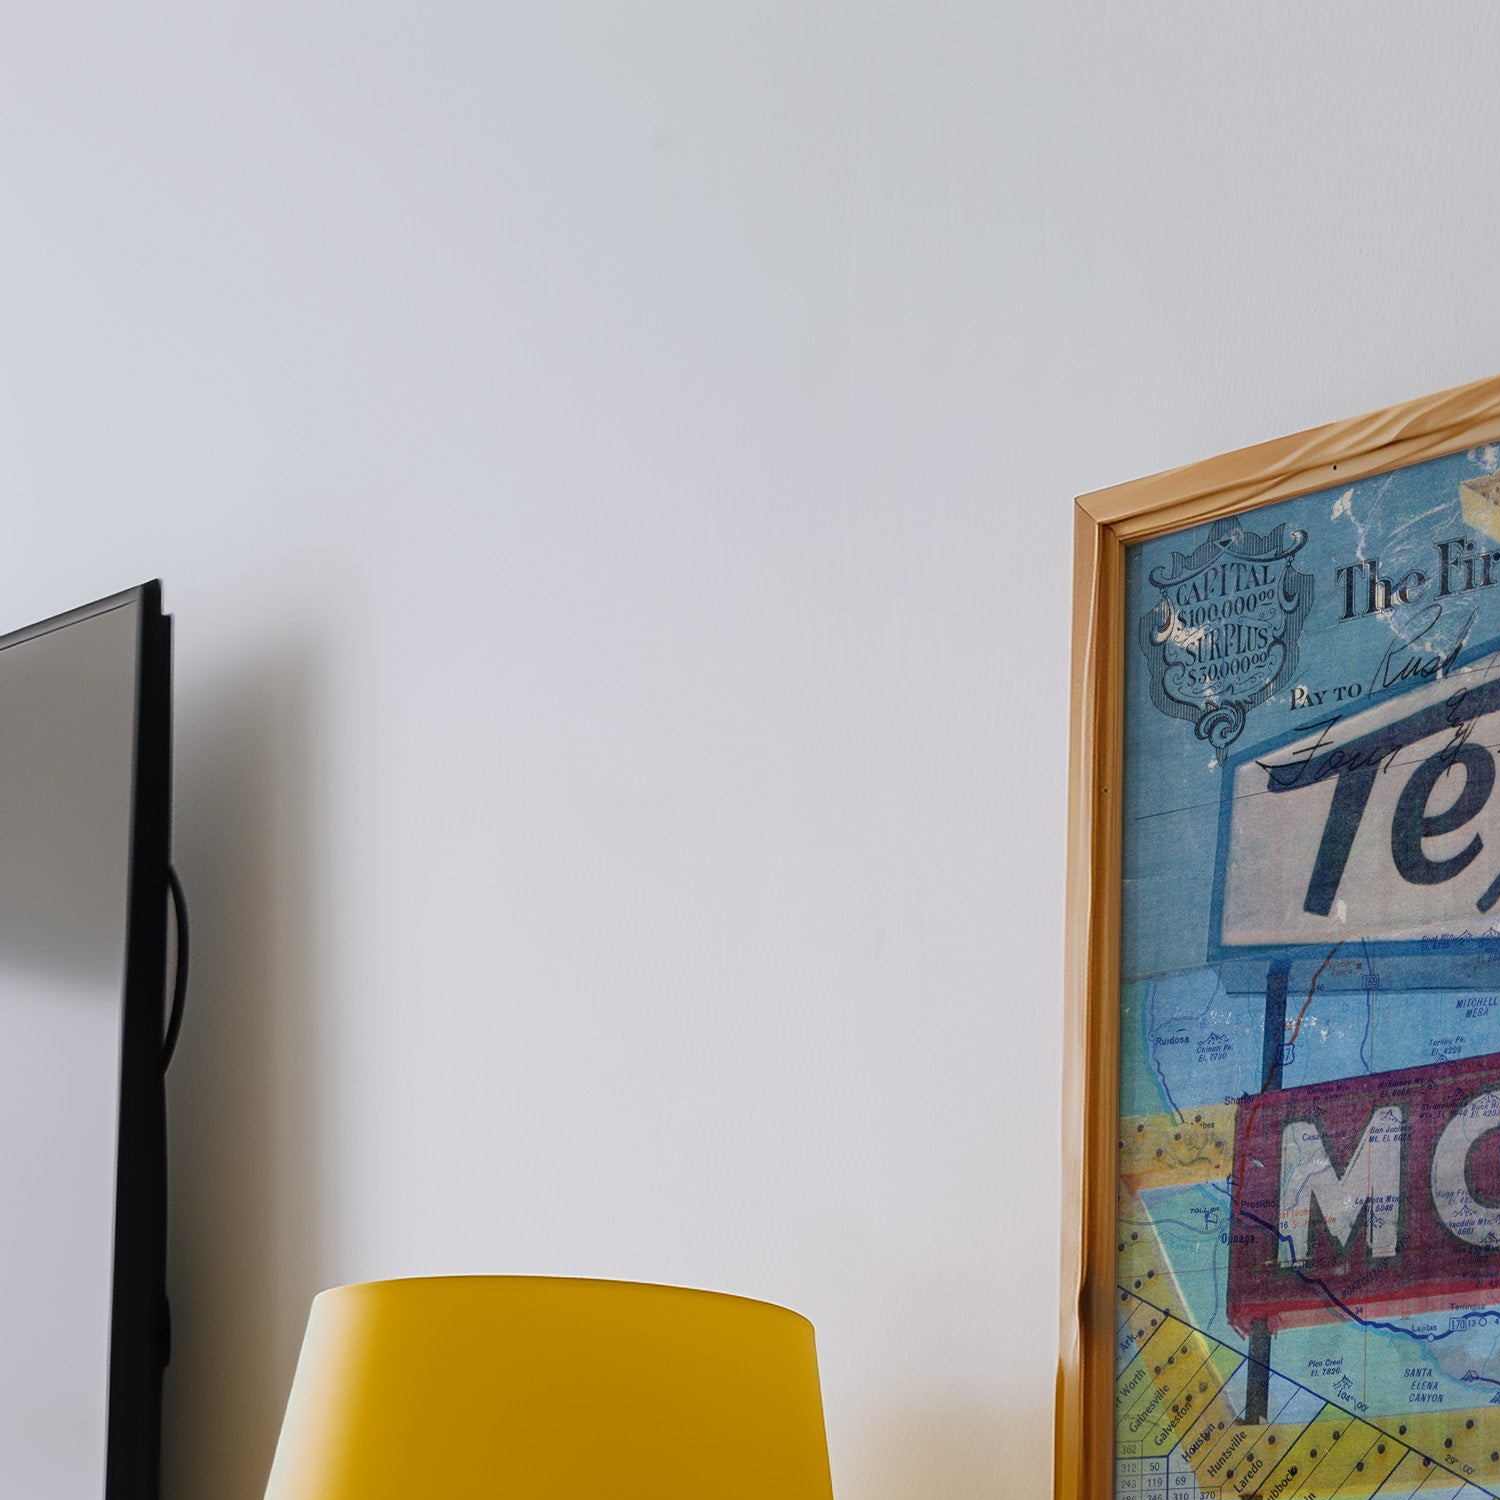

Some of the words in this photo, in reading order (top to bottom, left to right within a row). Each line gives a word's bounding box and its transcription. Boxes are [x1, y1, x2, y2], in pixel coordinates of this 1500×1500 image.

[1176, 562, 1276, 607] CAPITAL
[1335, 563, 1426, 623] The
[1185, 622, 1268, 667] SURPLUS
[1290, 686, 1327, 711] PAY
[1333, 682, 1363, 701] TO
[1455, 997, 1499, 1010] MITCHELL
[1464, 1008, 1489, 1019] MESA
[1155, 1034, 1190, 1046] Ruidosa
[1354, 1306, 1364, 1315] 34
[1450, 1303, 1486, 1312] Terlingua
[1450, 1318, 1466, 1330] 170
[1467, 1320, 1477, 1328] 13
[1308, 1359, 1323, 1368] Pico
[1321, 1367, 1341, 1376] 7820
[1404, 1367, 1433, 1378] SANTA
[1120, 1368, 1146, 1397] Worth
[1410, 1381, 1439, 1391] ELENA
[1408, 1393, 1445, 1404] CANYON
[1129, 1383, 1170, 1433] Gainesville
[1153, 1402, 1193, 1447] Galveston
[1181, 1422, 1216, 1463] Houston
[1207, 1429, 1248, 1478] Huntsville
[1149, 1461, 1160, 1472] 50
[1147, 1477, 1163, 1488] 119
[1175, 1475, 1187, 1486] 69
[1232, 1458, 1264, 1494] Laredo
[1200, 1490, 1216, 1500] 370
